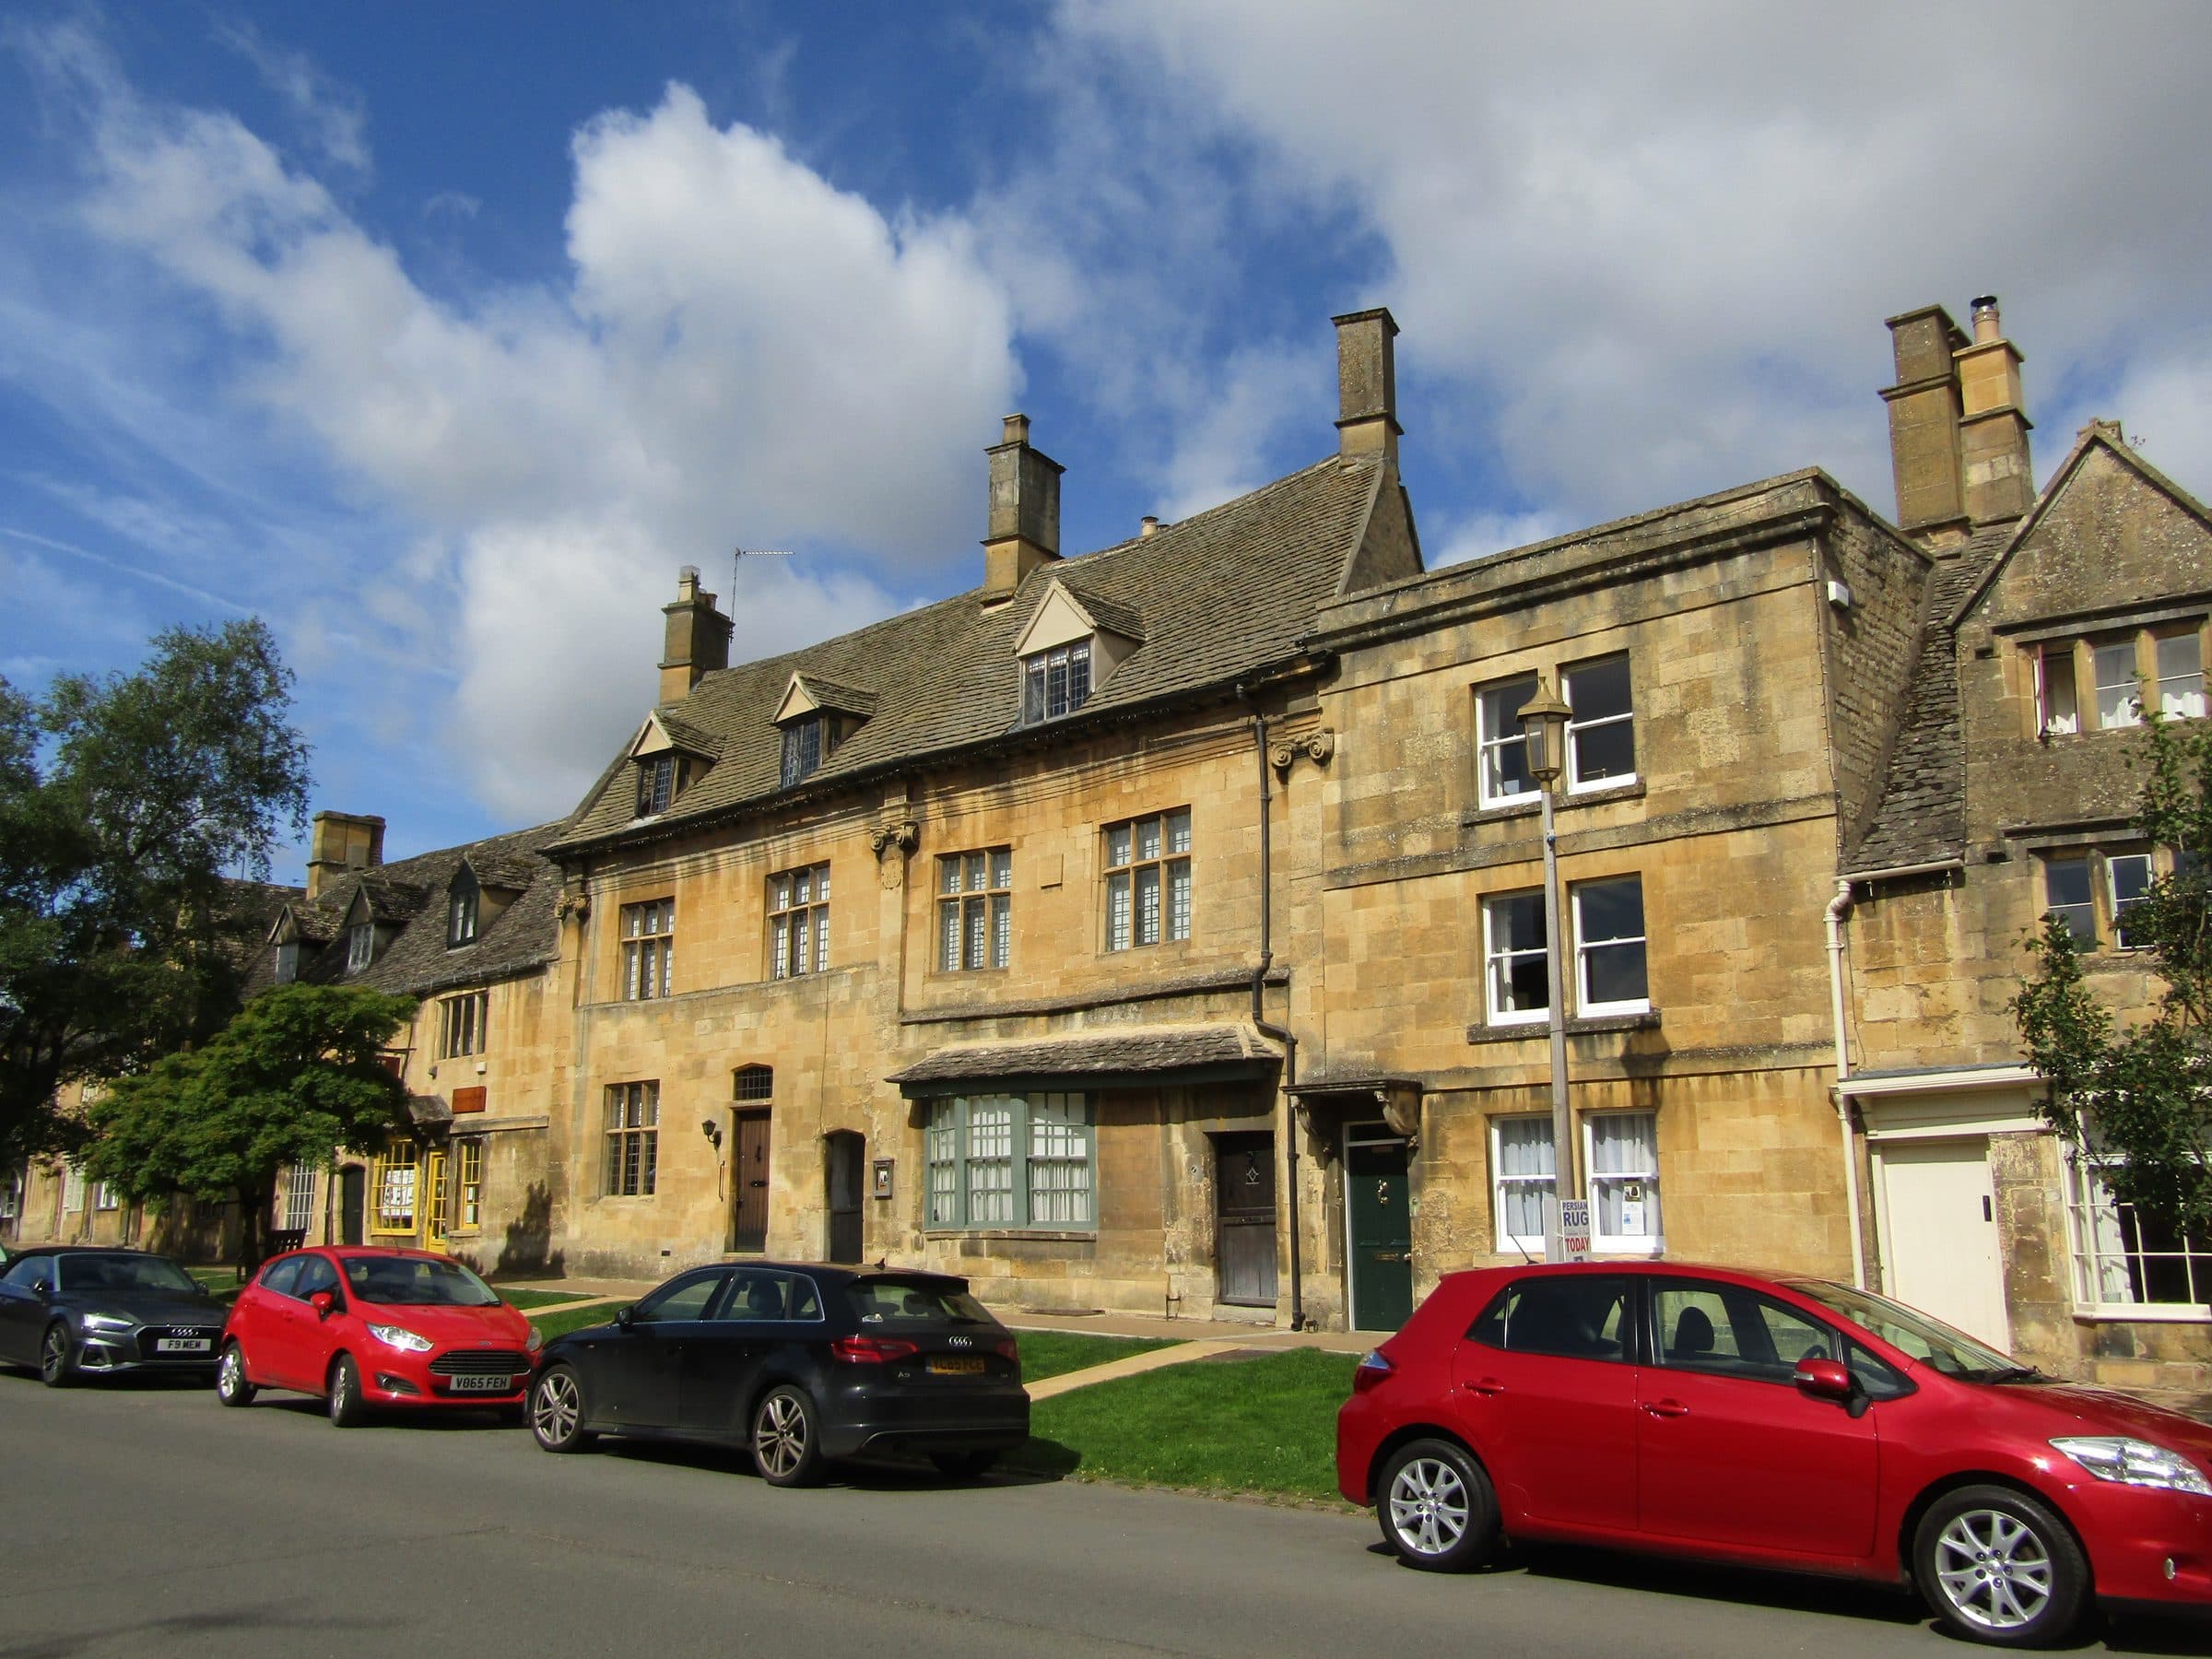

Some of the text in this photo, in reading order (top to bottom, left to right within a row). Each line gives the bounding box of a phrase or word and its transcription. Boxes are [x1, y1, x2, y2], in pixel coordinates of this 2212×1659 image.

[1562, 1201, 1588, 1210] PERSIAN
[1563, 1211, 1589, 1227] RUG
[1565, 1237, 1590, 1253] TODAY
[168, 1340, 181, 1349] F9
